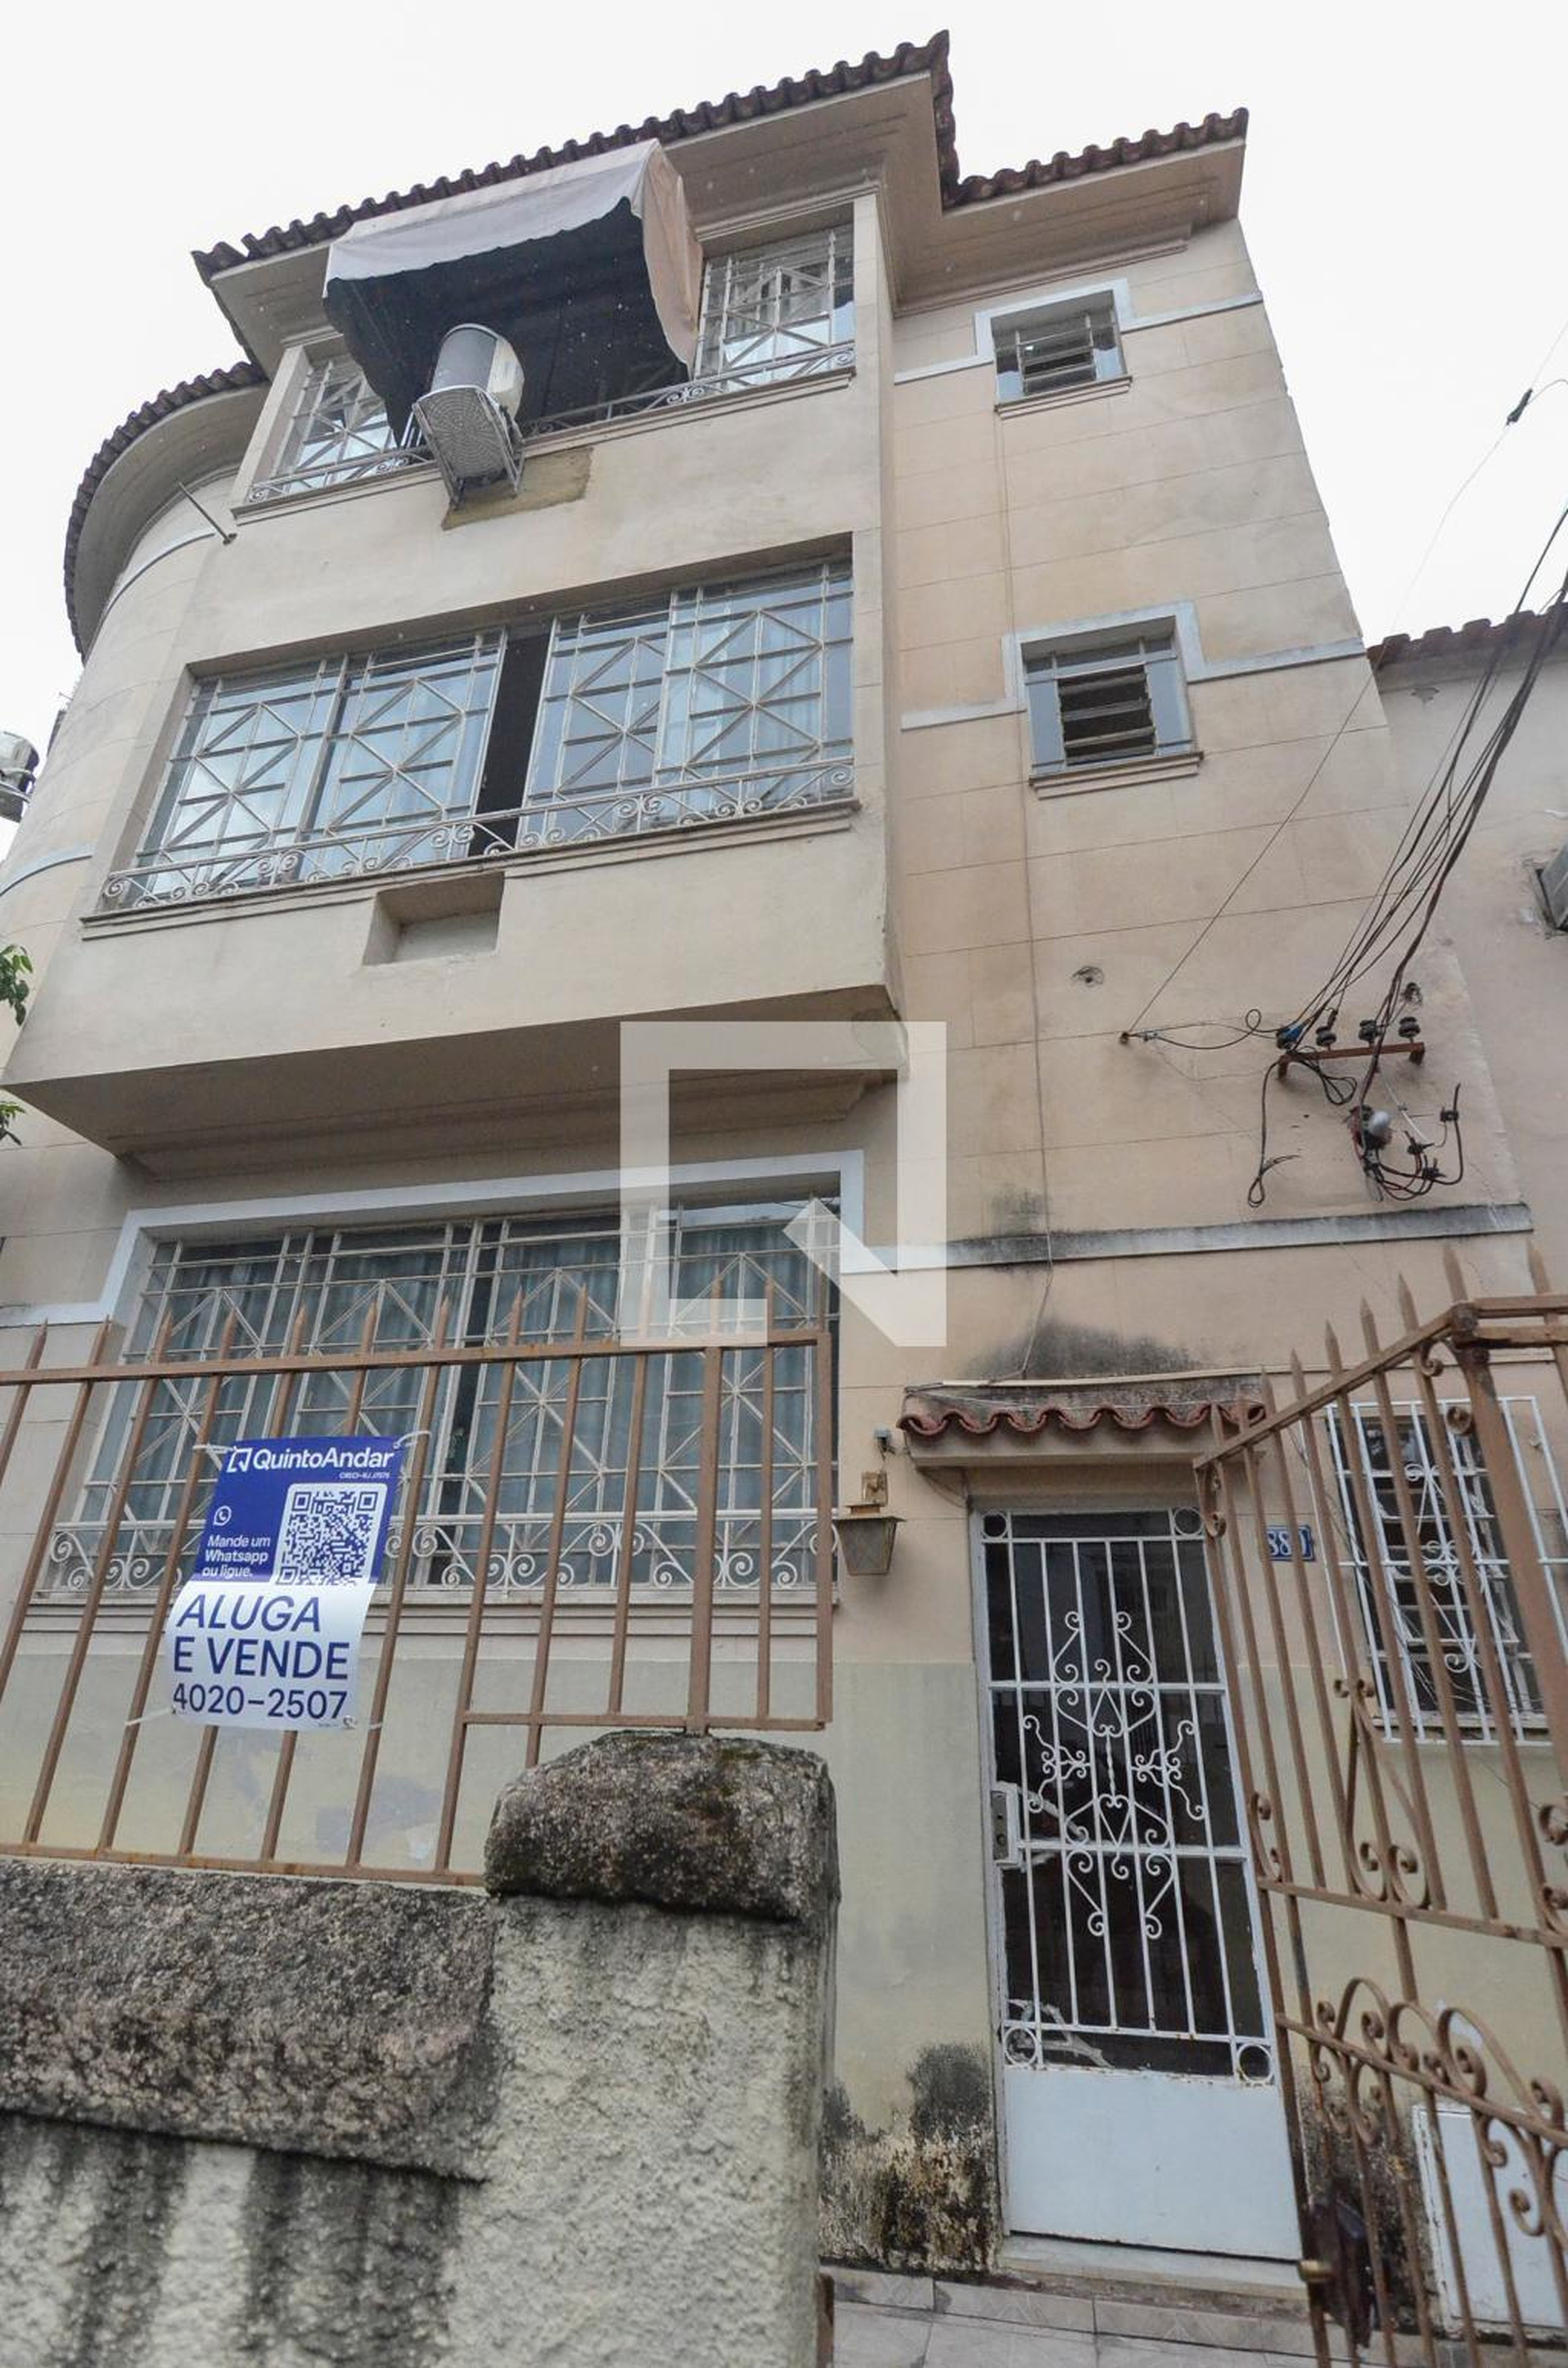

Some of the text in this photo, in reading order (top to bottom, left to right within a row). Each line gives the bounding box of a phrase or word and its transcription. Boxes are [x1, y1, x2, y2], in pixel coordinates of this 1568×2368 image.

[253, 1447, 394, 1470] QuintoAndar
[207, 1534, 271, 1547] Mande um
[205, 1549, 269, 1565] Whatsapp
[202, 1564, 253, 1580] ou ligue.
[176, 1594, 320, 1632] ALUGA
[174, 1636, 350, 1680] E VENDE
[173, 1683, 347, 1719] 4020-2507
